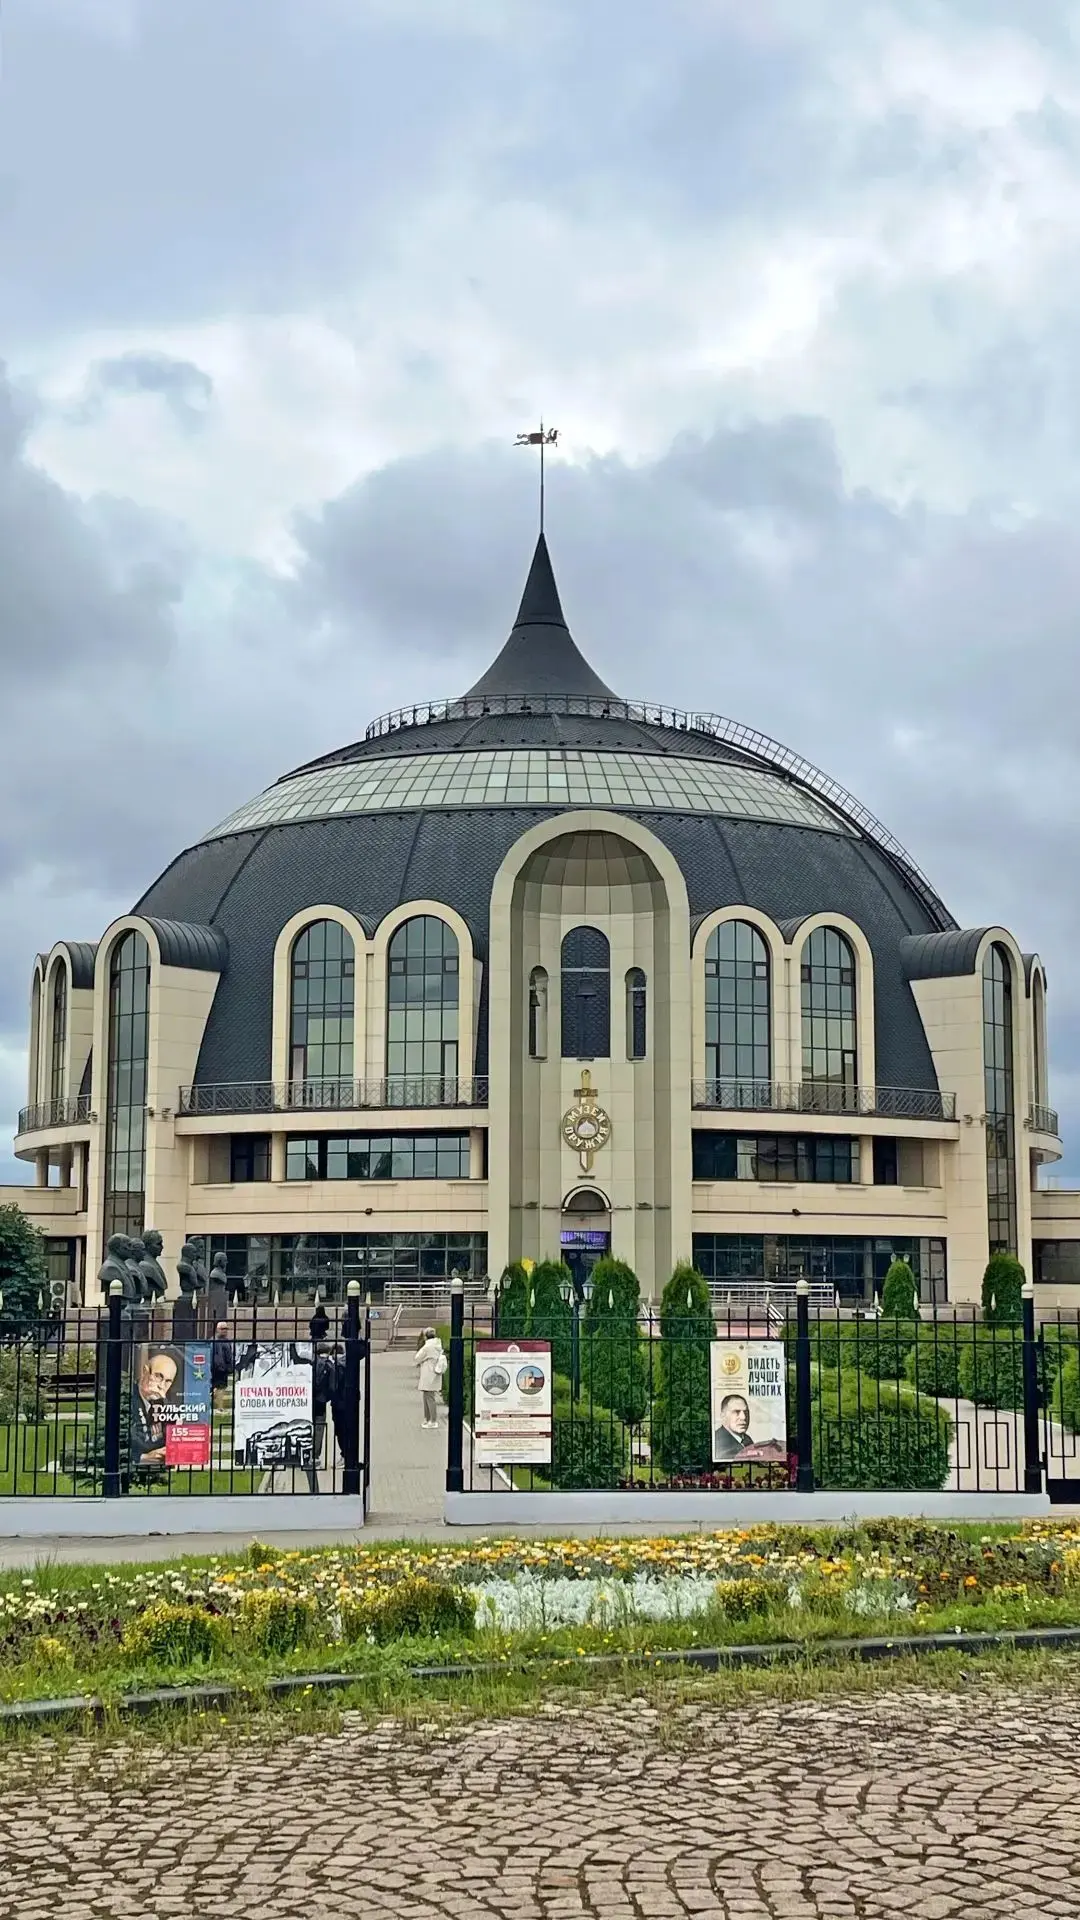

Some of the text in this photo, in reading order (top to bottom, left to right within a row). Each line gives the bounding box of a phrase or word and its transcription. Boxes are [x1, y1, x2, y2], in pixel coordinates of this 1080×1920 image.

[565, 1126, 608, 1149] ОРУЖИЯ
[748, 1371, 778, 1383] ЛУЧШЕ
[240, 1386, 308, 1397] ПЕЧАТЬ ЭПОХИ:
[748, 1385, 781, 1396] МНОГИХ
[152, 1403, 206, 1413] ТУЛЬСКИЙ
[240, 1398, 308, 1408] СЛОВА И ОБРАЗЫ
[152, 1413, 199, 1422] ТОКАРЕВ
[171, 1428, 189, 1437] 155
